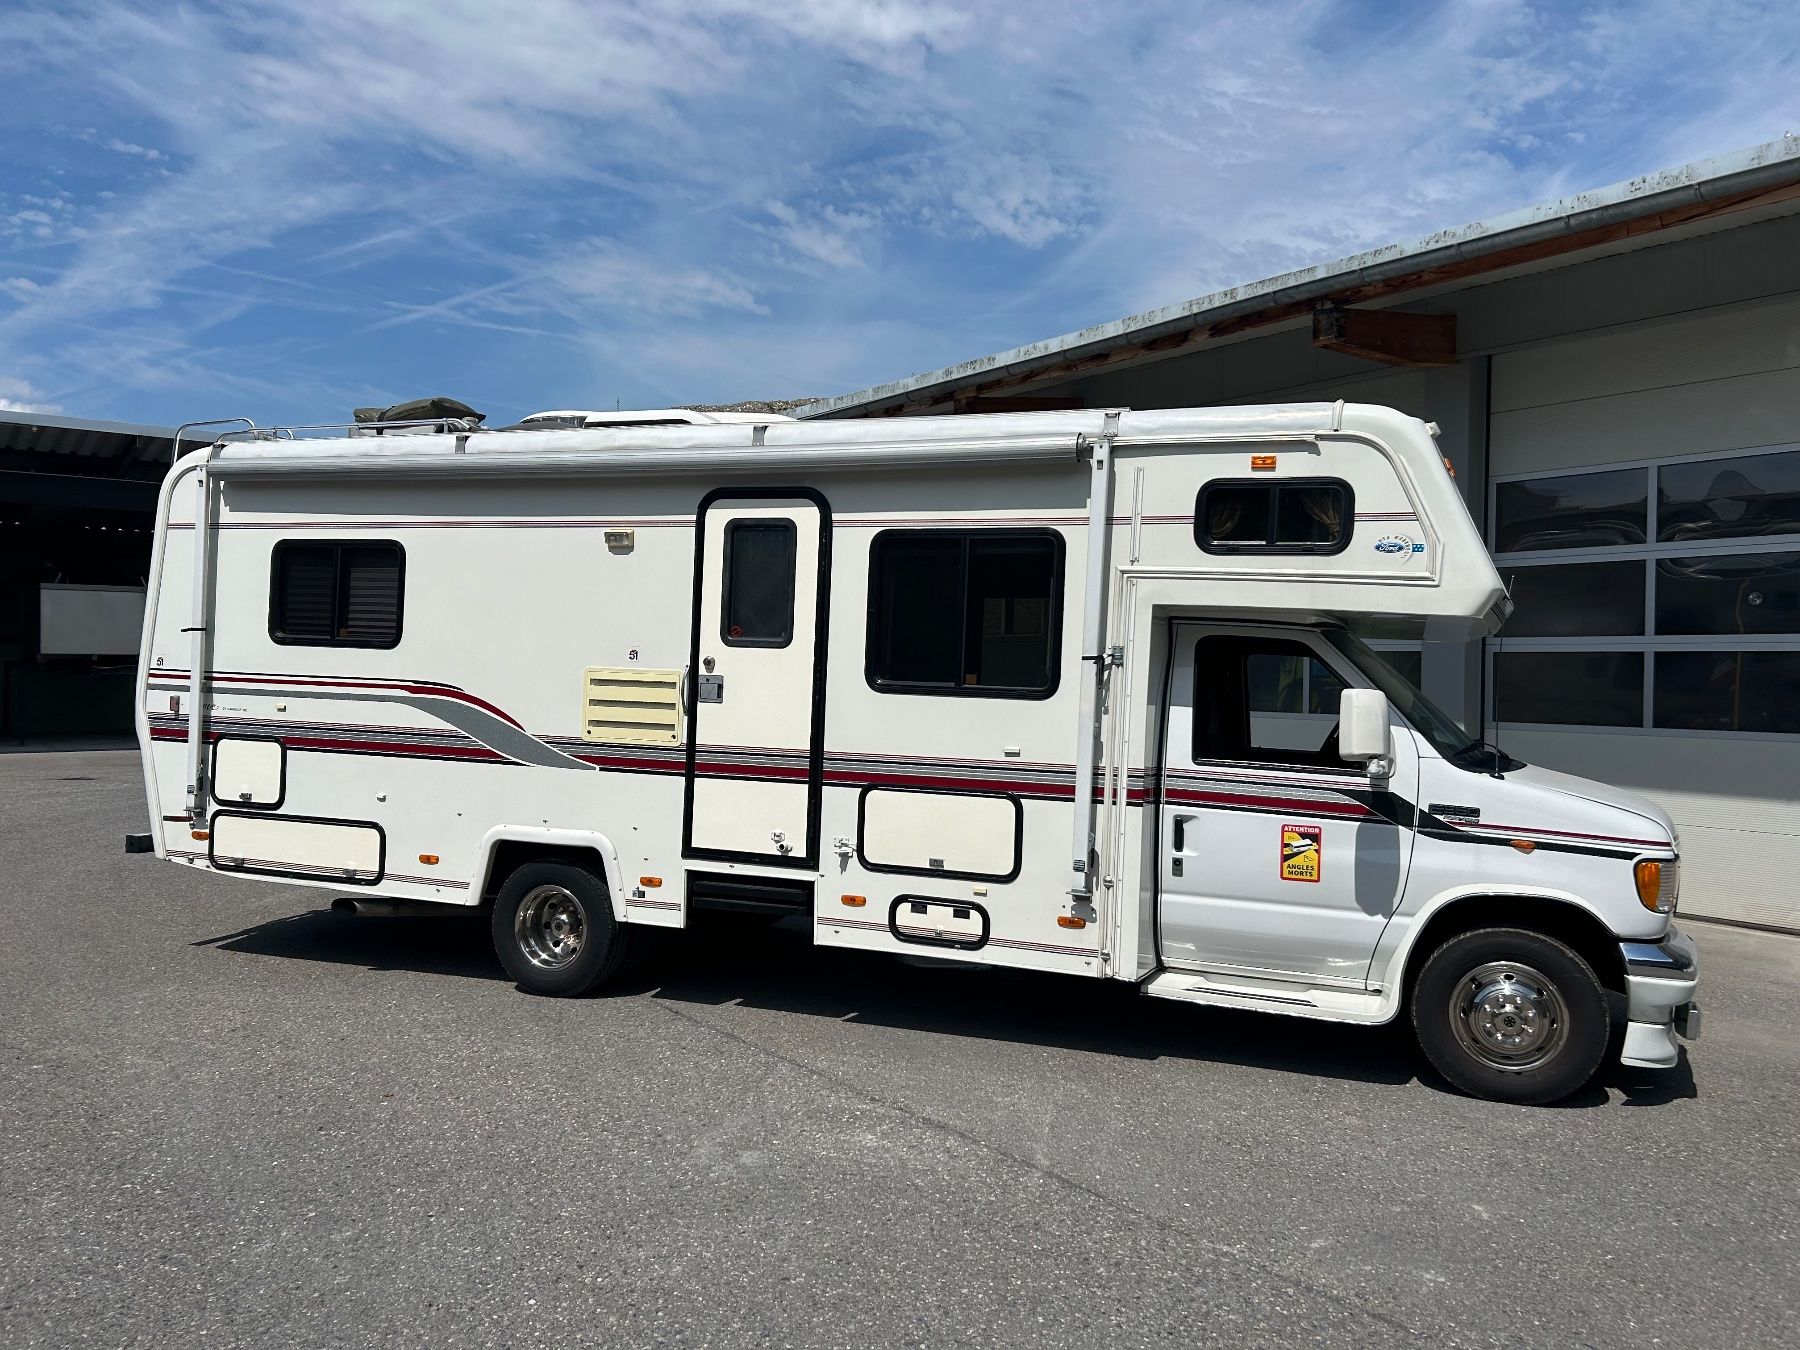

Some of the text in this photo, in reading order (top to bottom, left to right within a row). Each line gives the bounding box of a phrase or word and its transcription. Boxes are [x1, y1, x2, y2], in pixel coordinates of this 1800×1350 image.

[1283, 825, 1320, 833] ATTENTION
[1286, 863, 1315, 871] ANGLES
[1287, 869, 1313, 877] MORTS
